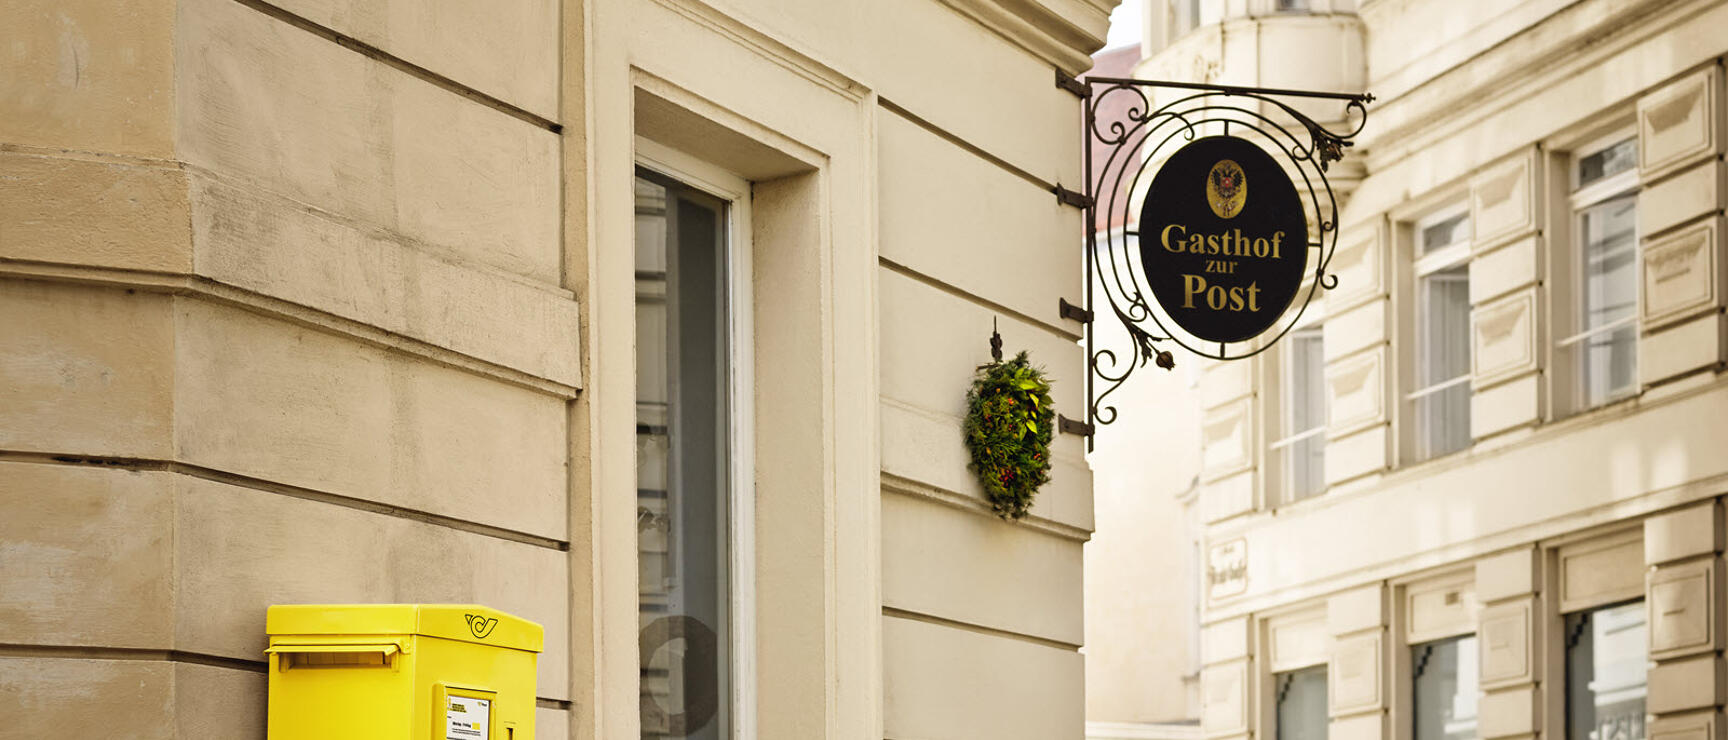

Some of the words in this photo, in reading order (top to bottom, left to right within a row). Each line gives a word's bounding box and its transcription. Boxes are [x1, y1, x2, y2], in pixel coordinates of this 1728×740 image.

[1161, 224, 1285, 258] Gasthof
[1205, 259, 1238, 273] zur
[1181, 273, 1262, 312] Post
